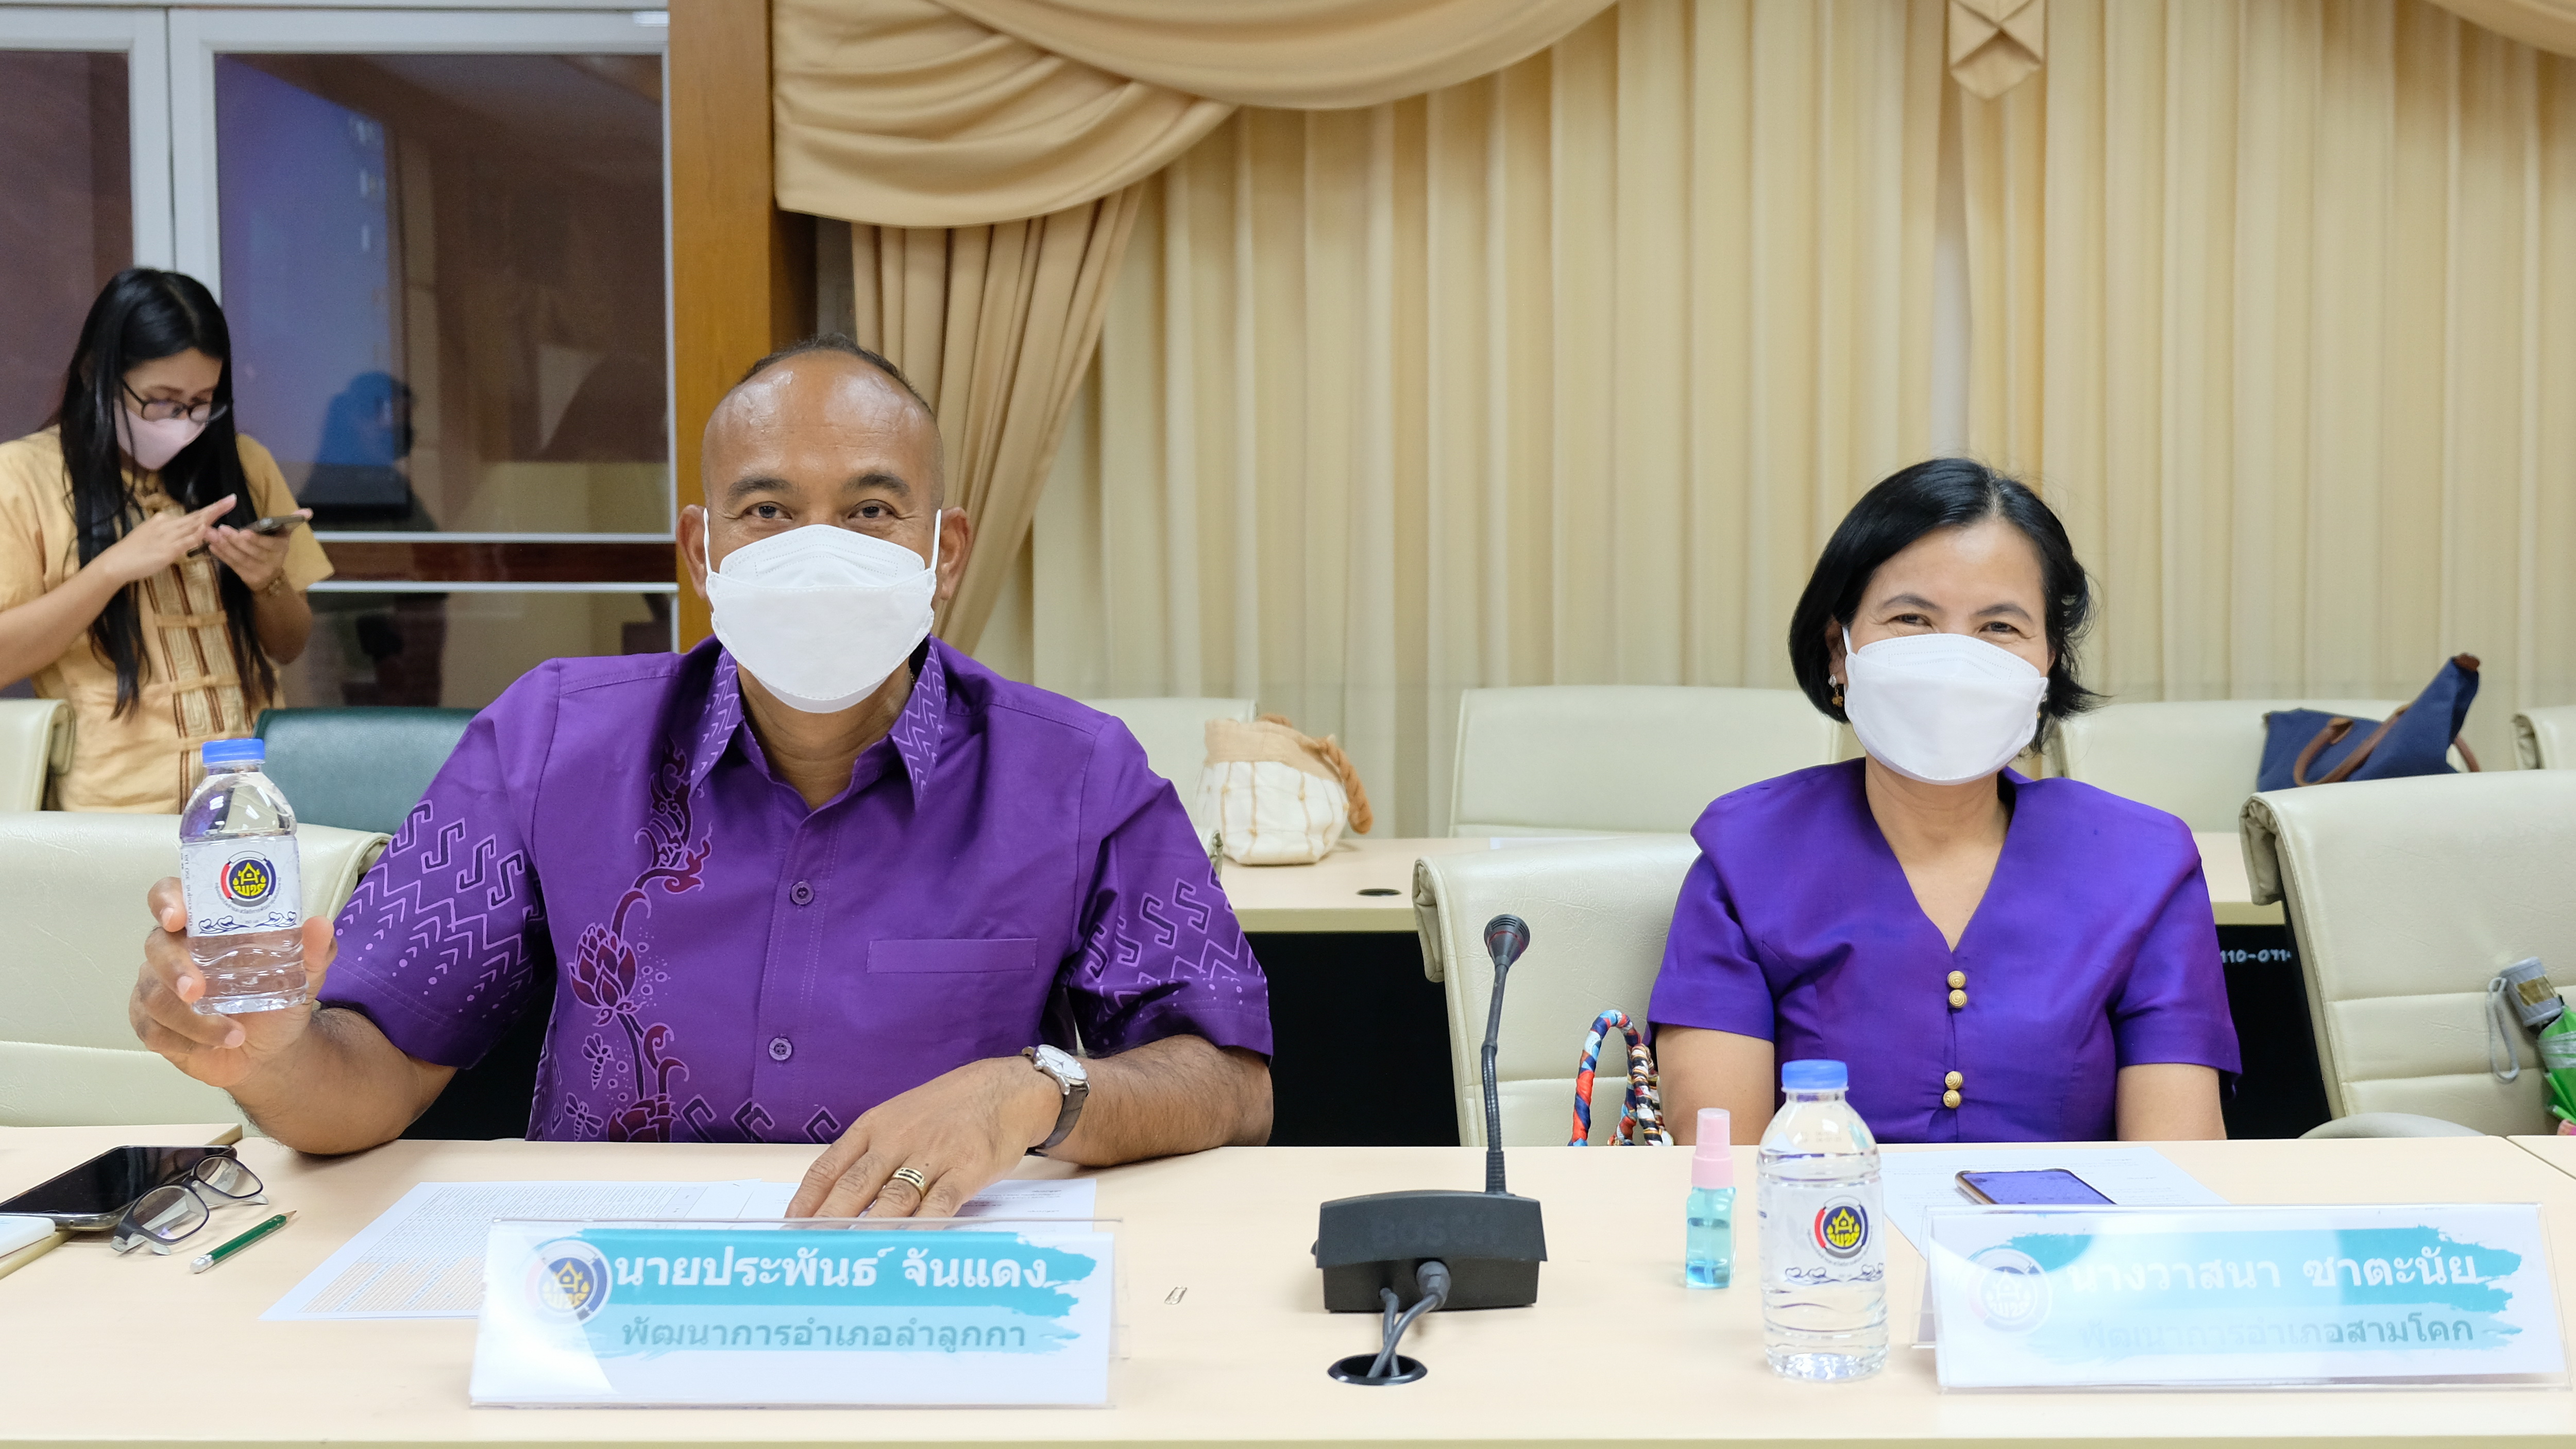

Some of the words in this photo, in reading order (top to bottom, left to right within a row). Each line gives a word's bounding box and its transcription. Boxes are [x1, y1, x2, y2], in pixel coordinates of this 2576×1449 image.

[615, 1246, 895, 1287] นายประพันธ์
[902, 1247, 1047, 1287] จันแดง
[2066, 1258, 2281, 1291] นางวาสนา
[622, 1316, 1025, 1353] พัฒนาการอำเภอลำลูกกา
[2078, 1311, 2474, 1348] พัฒนาการอำเภอสามโคก
